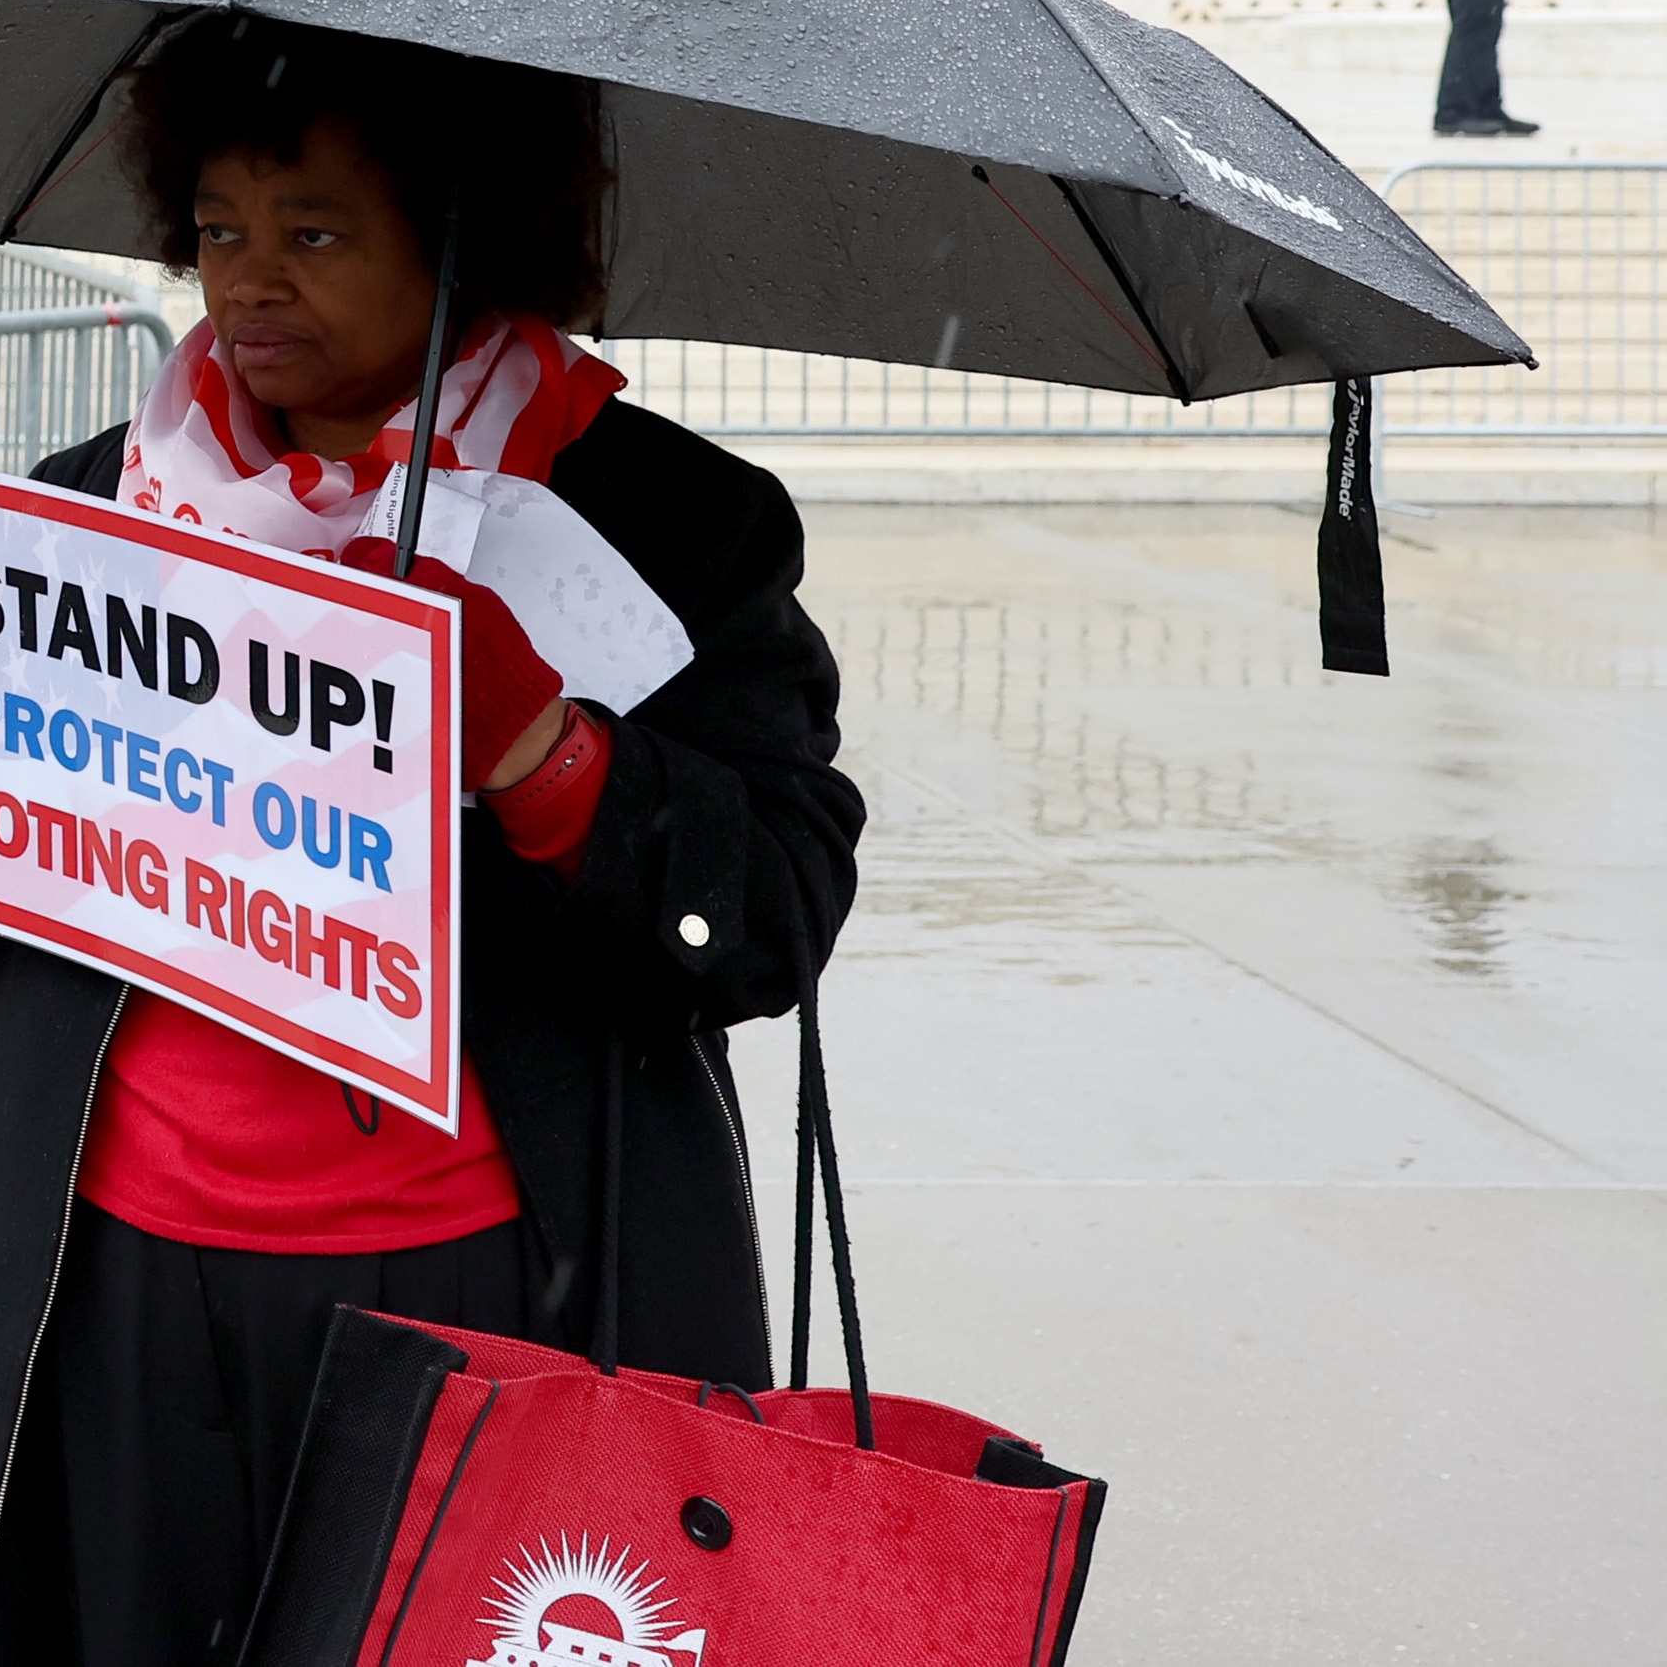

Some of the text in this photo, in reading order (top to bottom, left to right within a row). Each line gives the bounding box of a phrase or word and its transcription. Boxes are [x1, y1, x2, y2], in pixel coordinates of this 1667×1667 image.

[1338, 379, 1365, 519] TaylorMade
[385, 500, 398, 537] Rights
[249, 639, 395, 774] UP!
[253, 782, 393, 894] OUR
[185, 857, 423, 1020] RIGHTS
